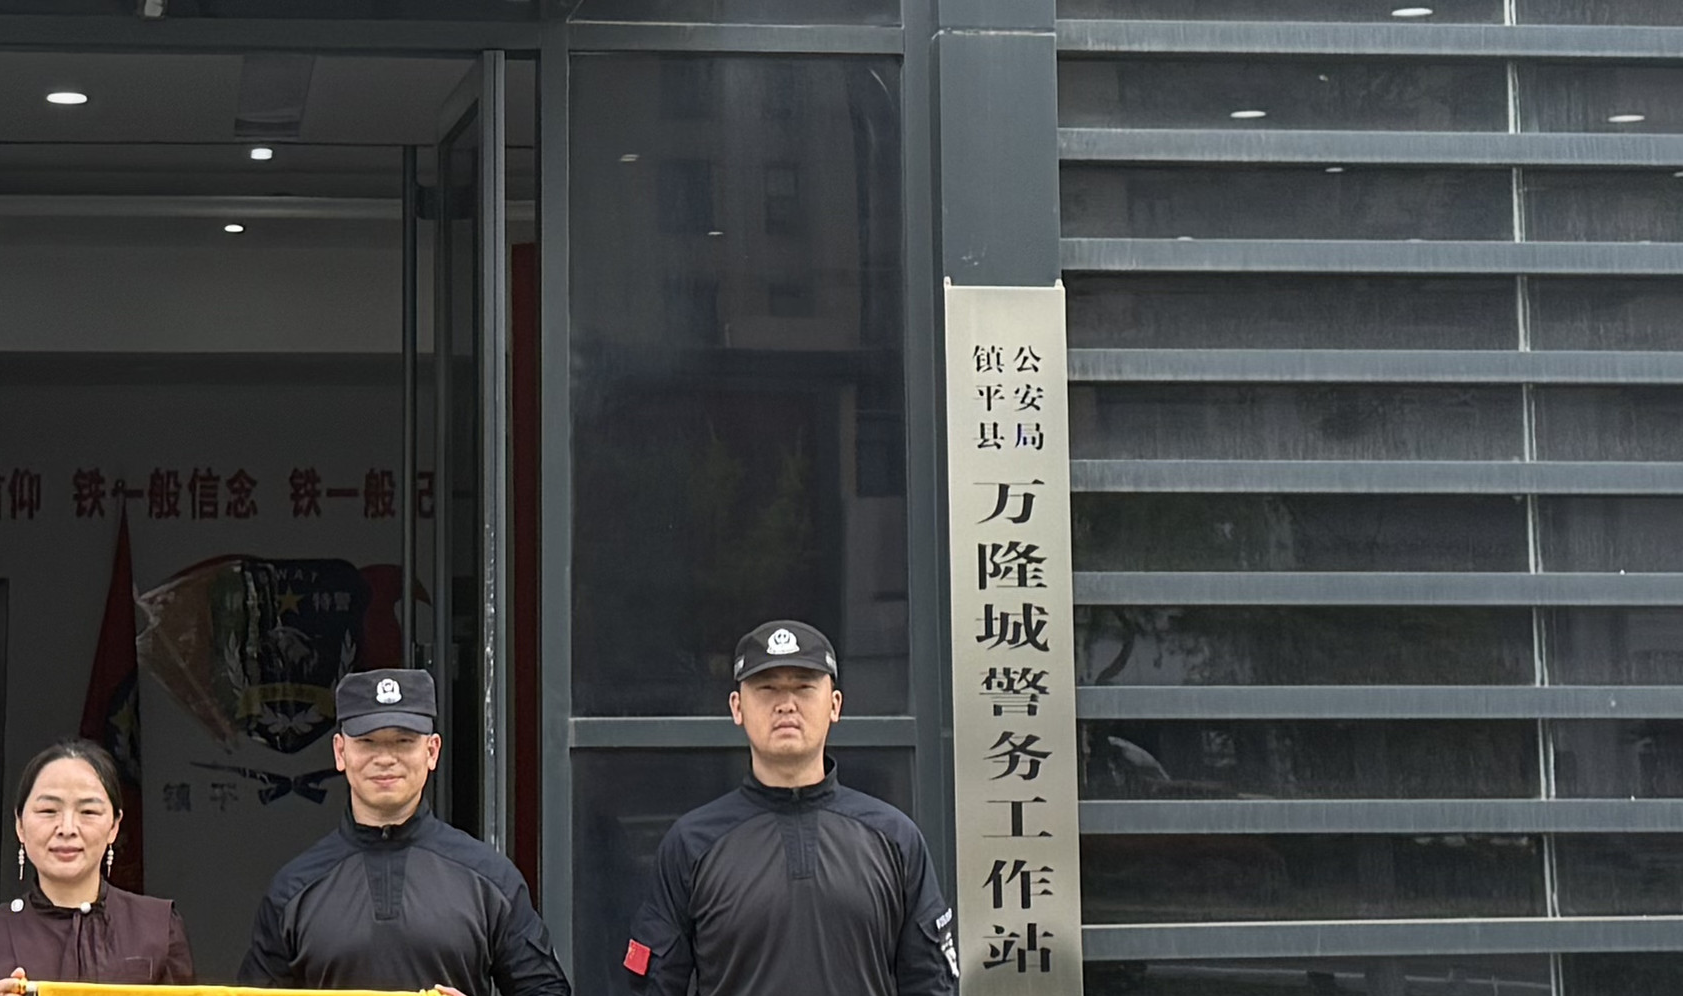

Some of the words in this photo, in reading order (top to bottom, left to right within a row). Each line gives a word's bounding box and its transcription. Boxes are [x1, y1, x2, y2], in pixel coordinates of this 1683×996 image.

[973, 345, 1006, 450] 镇平县
[1014, 346, 1044, 451] 公安局
[73, 467, 260, 520] 铁一般信念
[973, 479, 1054, 974] 万隆城警务工作站
